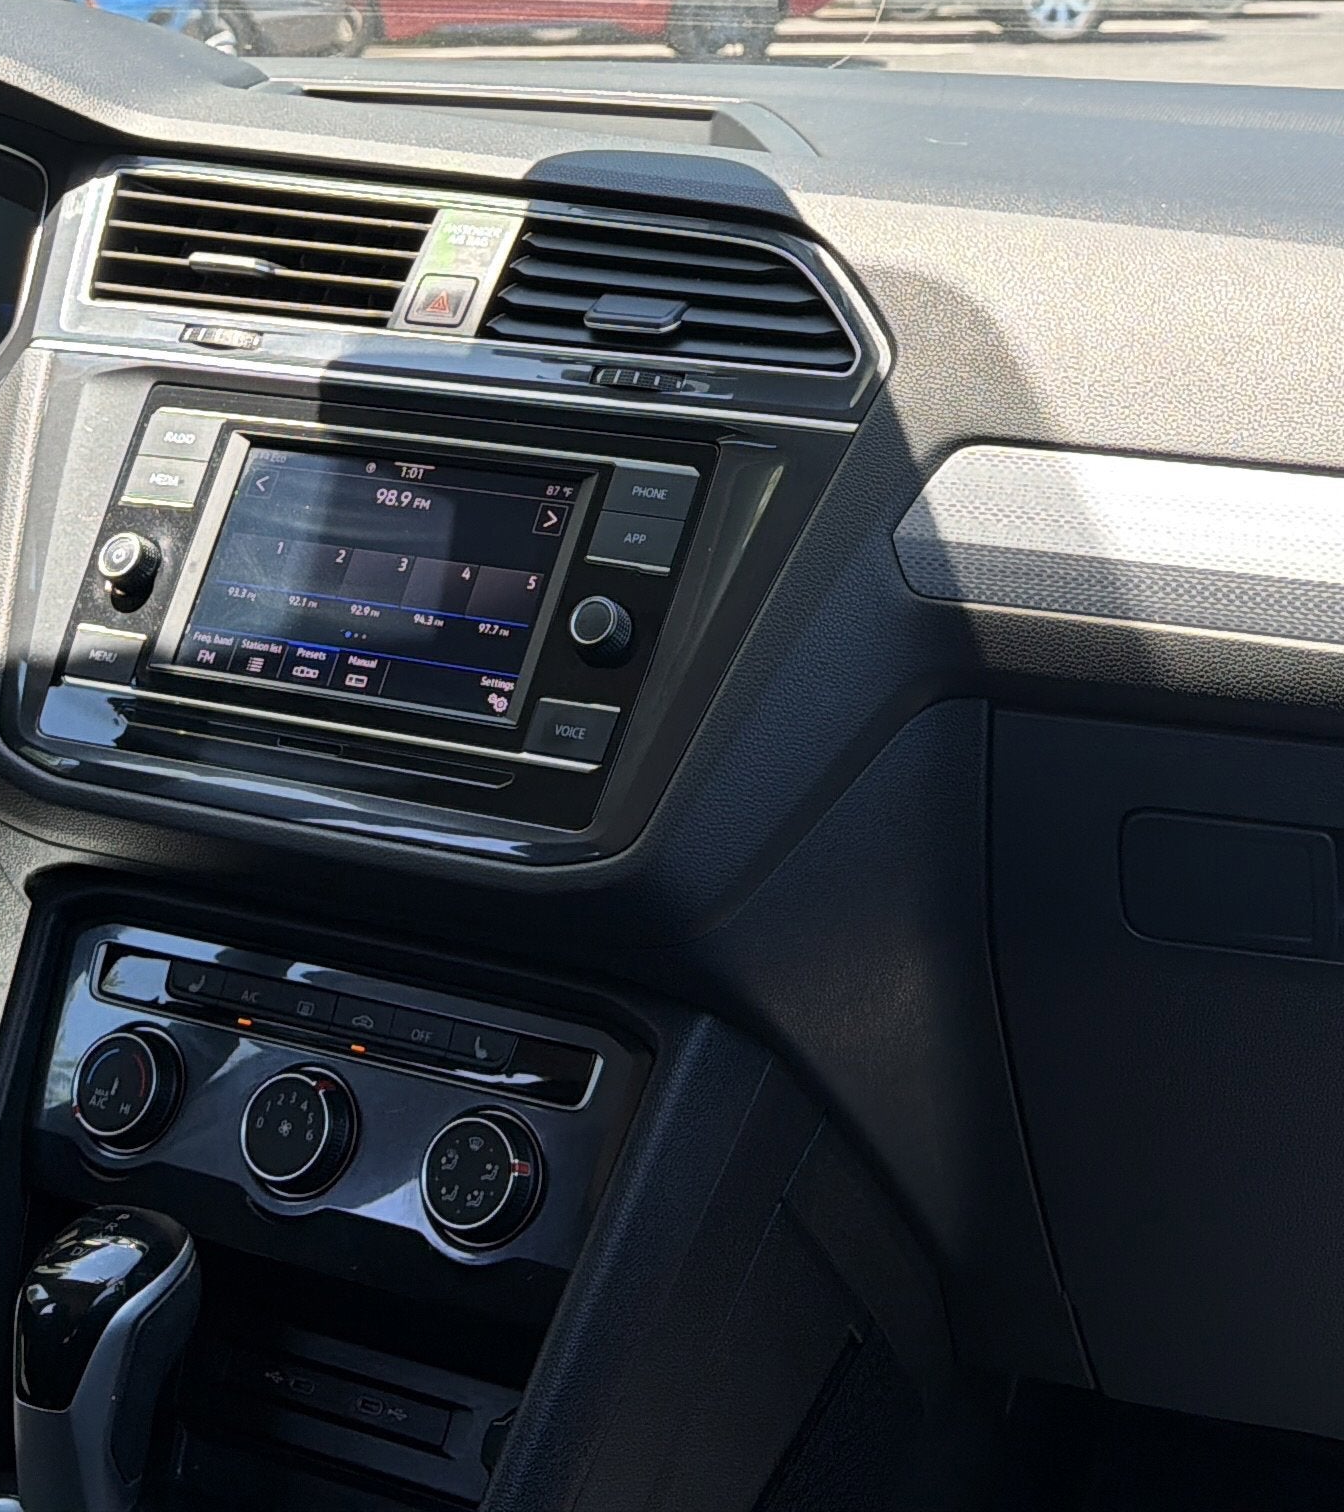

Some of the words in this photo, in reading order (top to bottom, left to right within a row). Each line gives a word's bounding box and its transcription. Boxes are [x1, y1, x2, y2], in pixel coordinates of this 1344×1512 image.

[400, 467, 424, 480] 1:01
[545, 485, 560, 497] 87
[631, 485, 668, 501] PHONE
[376, 488, 412, 507] 98.9
[413, 497, 432, 510] FM
[623, 532, 646, 545] APP
[277, 541, 284, 554] 1
[335, 549, 346, 563] 2
[397, 558, 408, 572] 3
[460, 567, 471, 580] 4
[527, 576, 538, 590] 5
[227, 586, 246, 599] 93.3
[288, 595, 307, 607] 92.1
[350, 604, 370, 616] 92.9
[413, 613, 433, 626] 94.3
[478, 623, 498, 635] 97.7
[213, 634, 234, 646] band
[241, 639, 269, 652] Station
[269, 643, 283, 654] list
[88, 648, 118, 663] MENU
[197, 650, 216, 664] FM
[296, 647, 327, 661] Presets
[348, 655, 378, 669] Manual
[480, 675, 515, 692] Settings
[555, 724, 587, 740] VOICE
[241, 991, 260, 1003] A/C
[411, 1029, 432, 1043] OFF
[89, 1096, 107, 1110] A/C
[277, 1093, 285, 1106] 2
[290, 1092, 298, 1104] 3
[120, 1103, 132, 1116] HI
[265, 1100, 272, 1112] 1
[300, 1100, 308, 1112] 4
[257, 1117, 264, 1129] 0
[307, 1112, 314, 1125] 5
[306, 1129, 314, 1142] 6
